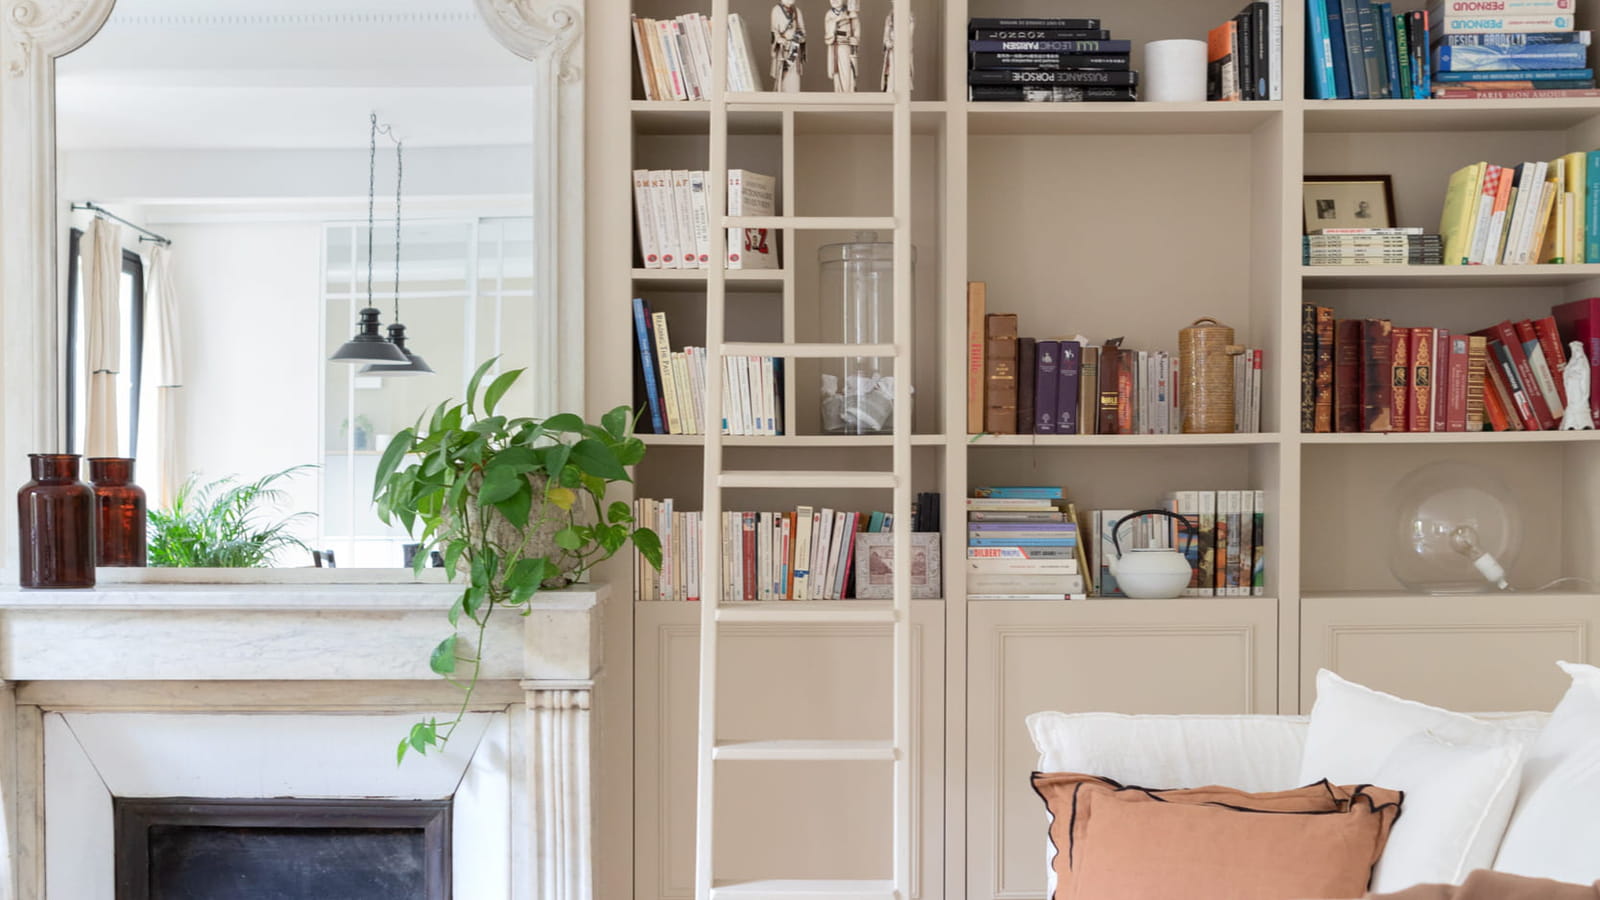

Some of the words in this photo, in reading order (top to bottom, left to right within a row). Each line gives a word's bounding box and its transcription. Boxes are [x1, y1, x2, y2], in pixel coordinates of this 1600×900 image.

[1453, 1, 1505, 11] PERNOUD
[1451, 19, 1503, 29] PERNOUD
[989, 31, 1046, 39] LONDON
[1448, 35, 1478, 46] DESIGN
[1484, 34, 1527, 46] BROOKLYN
[1002, 41, 1039, 50] PARISIEN
[1040, 41, 1061, 50] CHIC
[1061, 41, 1072, 50] LE
[1076, 41, 1099, 51] ELLE
[1012, 72, 1055, 82] PORSCHE
[1056, 72, 1109, 82] PUISSANCE
[1476, 91, 1504, 99] PARIS
[1533, 90, 1567, 98] AMOUR
[662, 360, 671, 376] PAST
